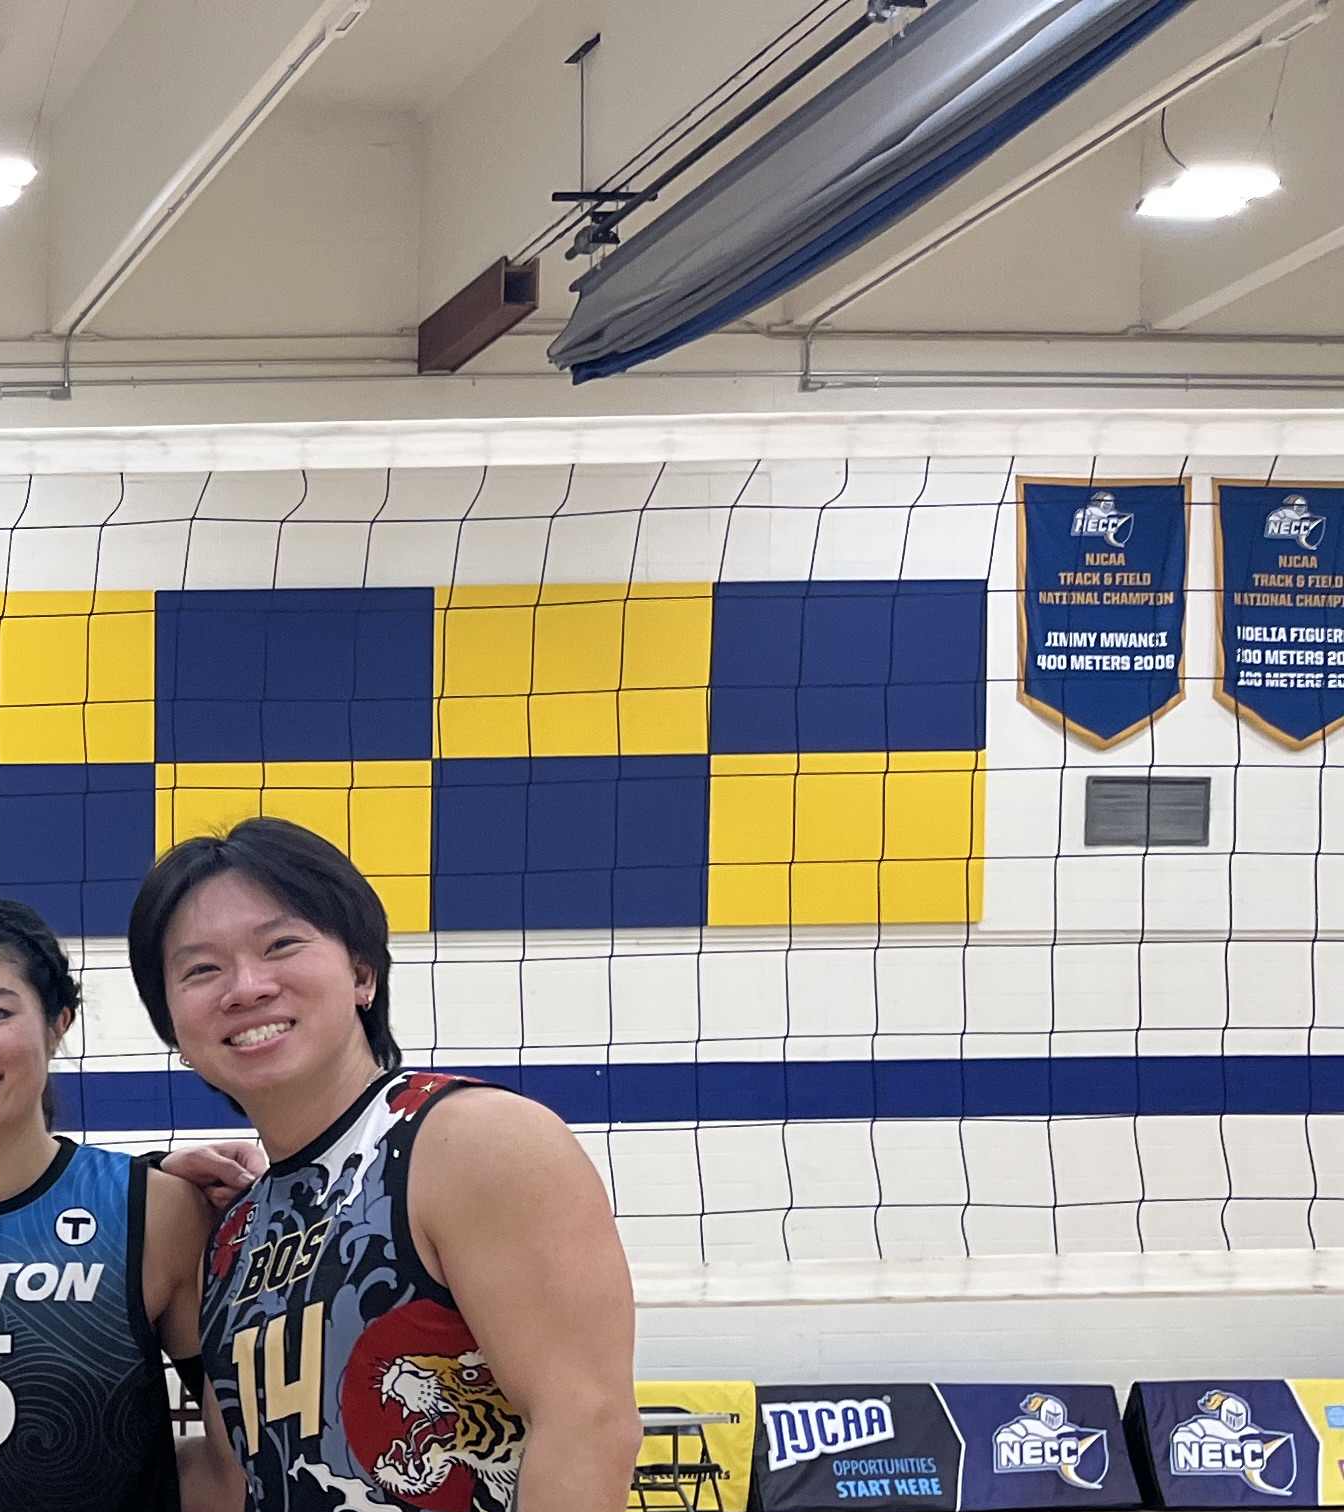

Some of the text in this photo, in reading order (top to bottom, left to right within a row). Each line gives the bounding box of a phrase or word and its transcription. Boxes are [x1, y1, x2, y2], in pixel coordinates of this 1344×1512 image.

[1269, 521, 1310, 534] NECC
[1085, 553, 1126, 566] NJCAA
[1278, 555, 1318, 568] NJCAA
[1057, 572, 1100, 586] TRACK
[1115, 573, 1151, 586] FIELD
[1253, 573, 1294, 587] TRACK
[1307, 574, 1344, 588] FIELD
[1039, 591, 1174, 606] NATIONAL CHAMPION
[1234, 592, 1294, 606] NATIONAL
[1045, 631, 1097, 648] JIMMY
[1290, 627, 1344, 643] FIGUER
[1037, 654, 1067, 670] 400
[1070, 655, 1131, 671] METERS
[1265, 650, 1324, 665] METERS
[1265, 672, 1325, 688] METERS
[62, 1217, 91, 1240] T
[232, 1217, 333, 1306] BOS
[232, 1302, 325, 1456] 14
[768, 1404, 889, 1463] NJCAA
[999, 1440, 1079, 1466] NECC
[1177, 1442, 1265, 1469] NECC
[833, 1458, 936, 1476] OPPORTUNITIES
[836, 1478, 943, 1499] START HERE
